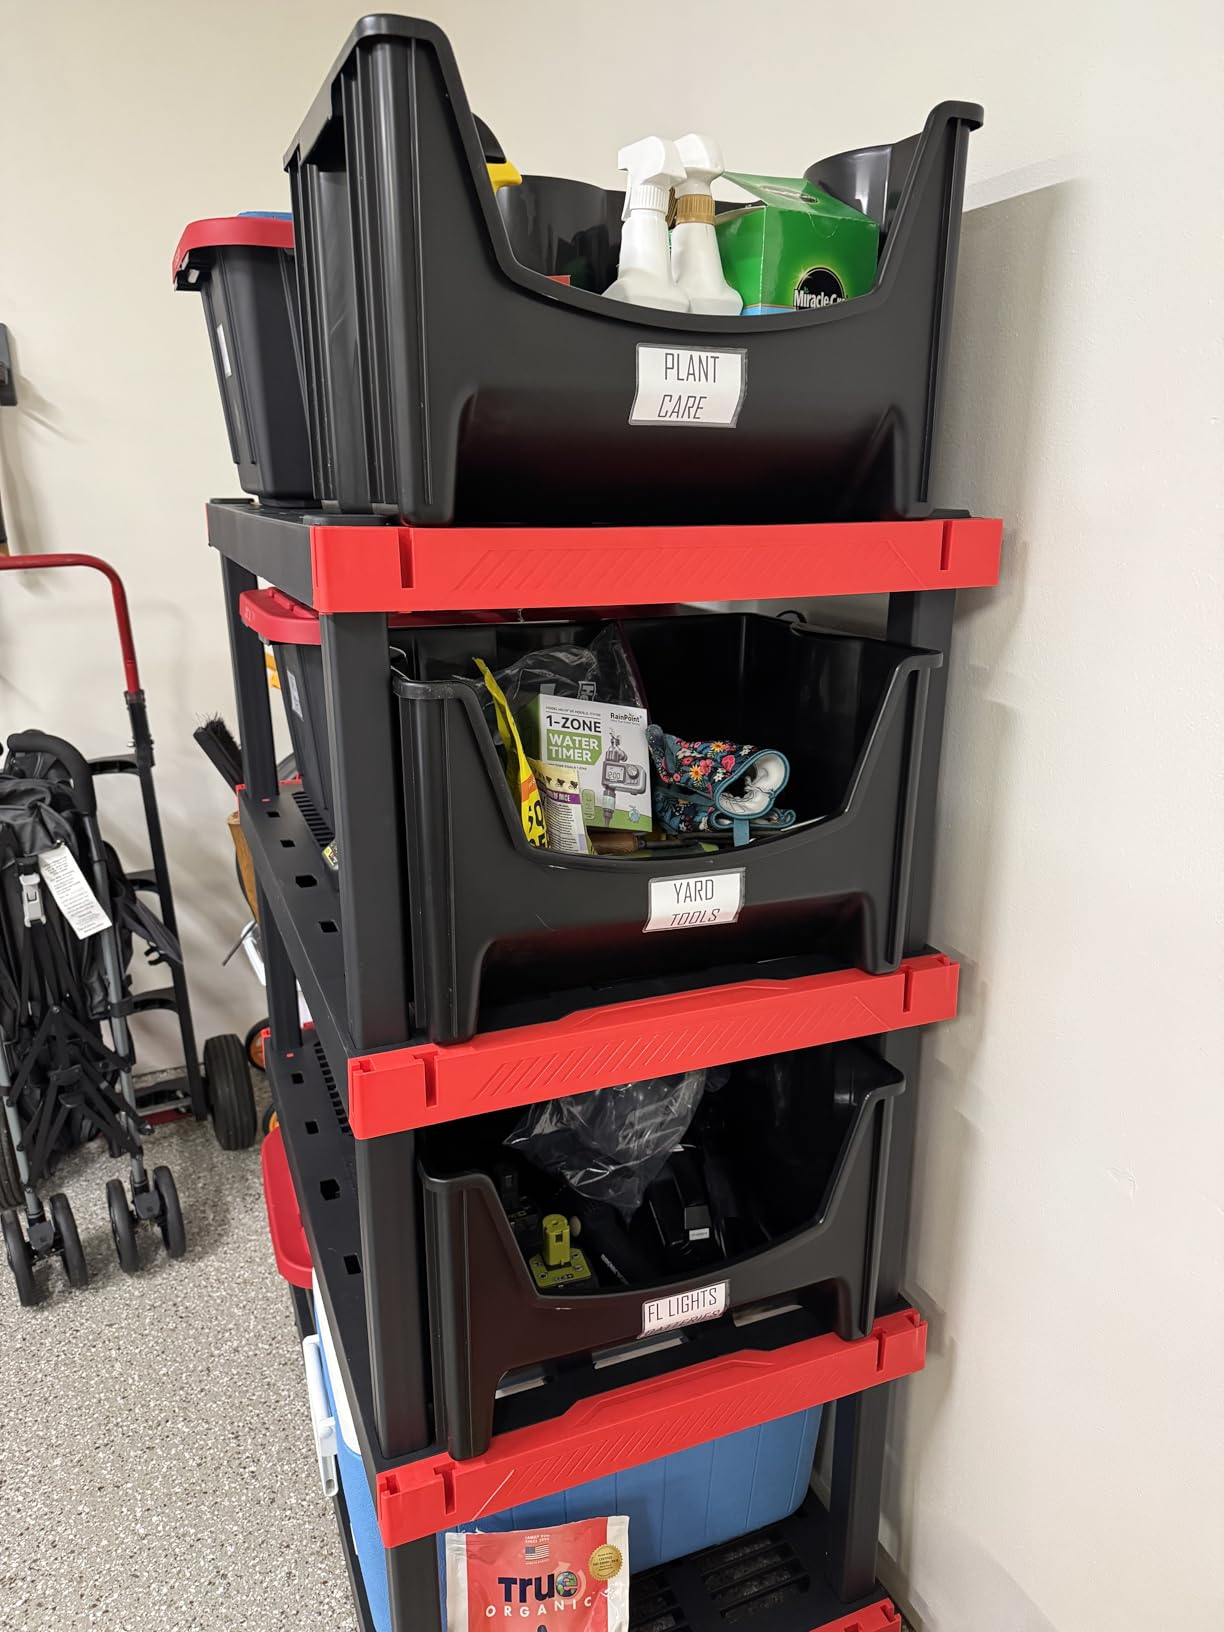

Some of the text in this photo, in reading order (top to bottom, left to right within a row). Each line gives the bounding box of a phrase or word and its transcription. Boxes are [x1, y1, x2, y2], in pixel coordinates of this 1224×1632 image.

[664, 352, 720, 384] PLANT
[657, 394, 707, 420] CARE
[546, 715, 602, 734] 1-ZONE
[549, 733, 599, 750] WATER
[548, 746, 592, 762] TIMER
[673, 879, 714, 904] YARD
[670, 908, 720, 927] TOOLS
[648, 1287, 717, 1323] FL LIGHTS
[497, 1570, 578, 1603] True
[486, 1596, 592, 1617] ORGANIC
